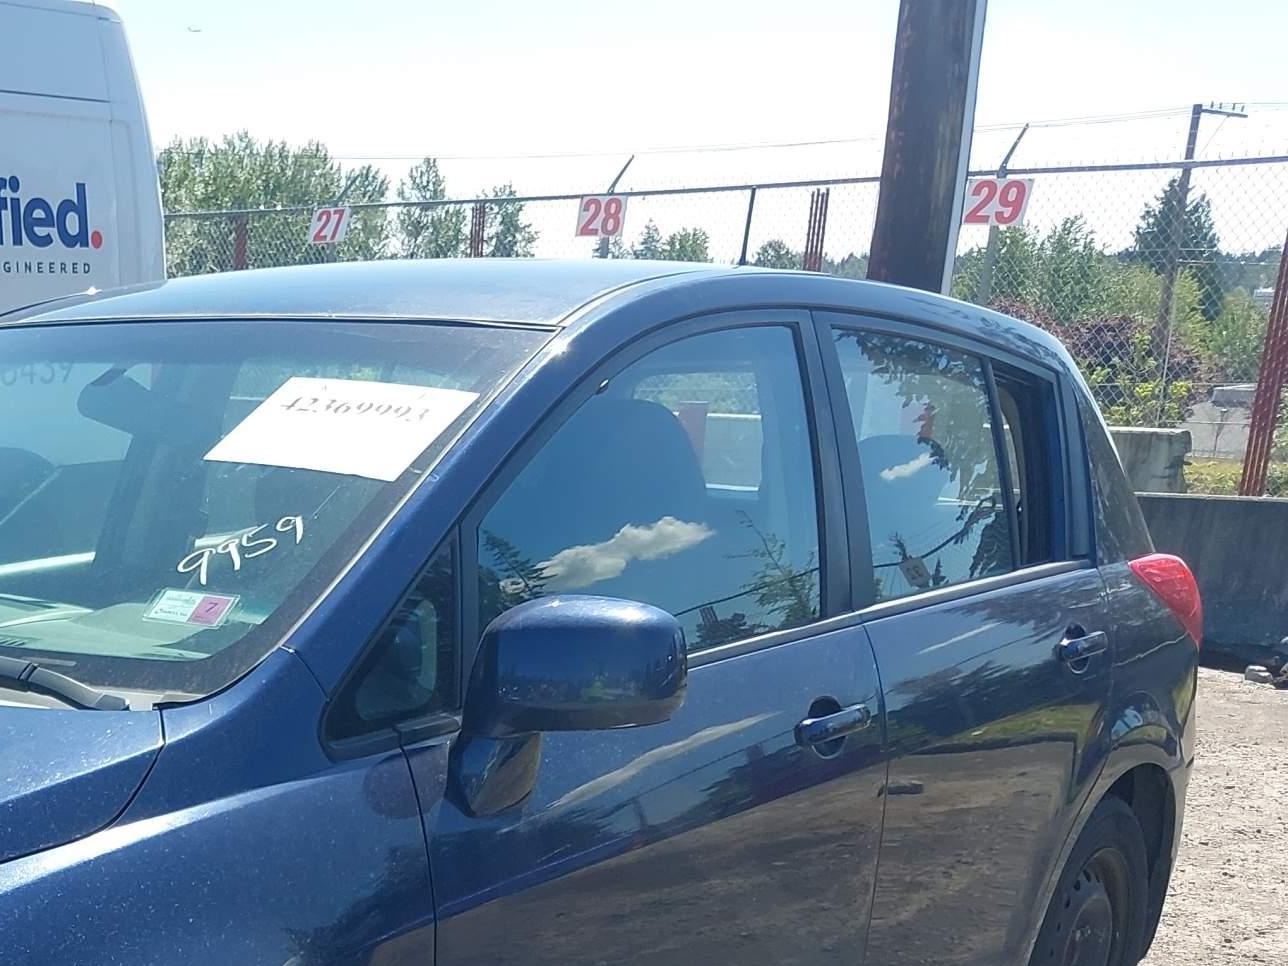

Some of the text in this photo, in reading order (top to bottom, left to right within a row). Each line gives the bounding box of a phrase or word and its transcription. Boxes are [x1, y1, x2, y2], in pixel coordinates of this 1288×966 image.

[580, 197, 622, 236] 28
[963, 180, 1027, 225] 29
[312, 208, 345, 242] 27
[176, 515, 305, 586] 9959
